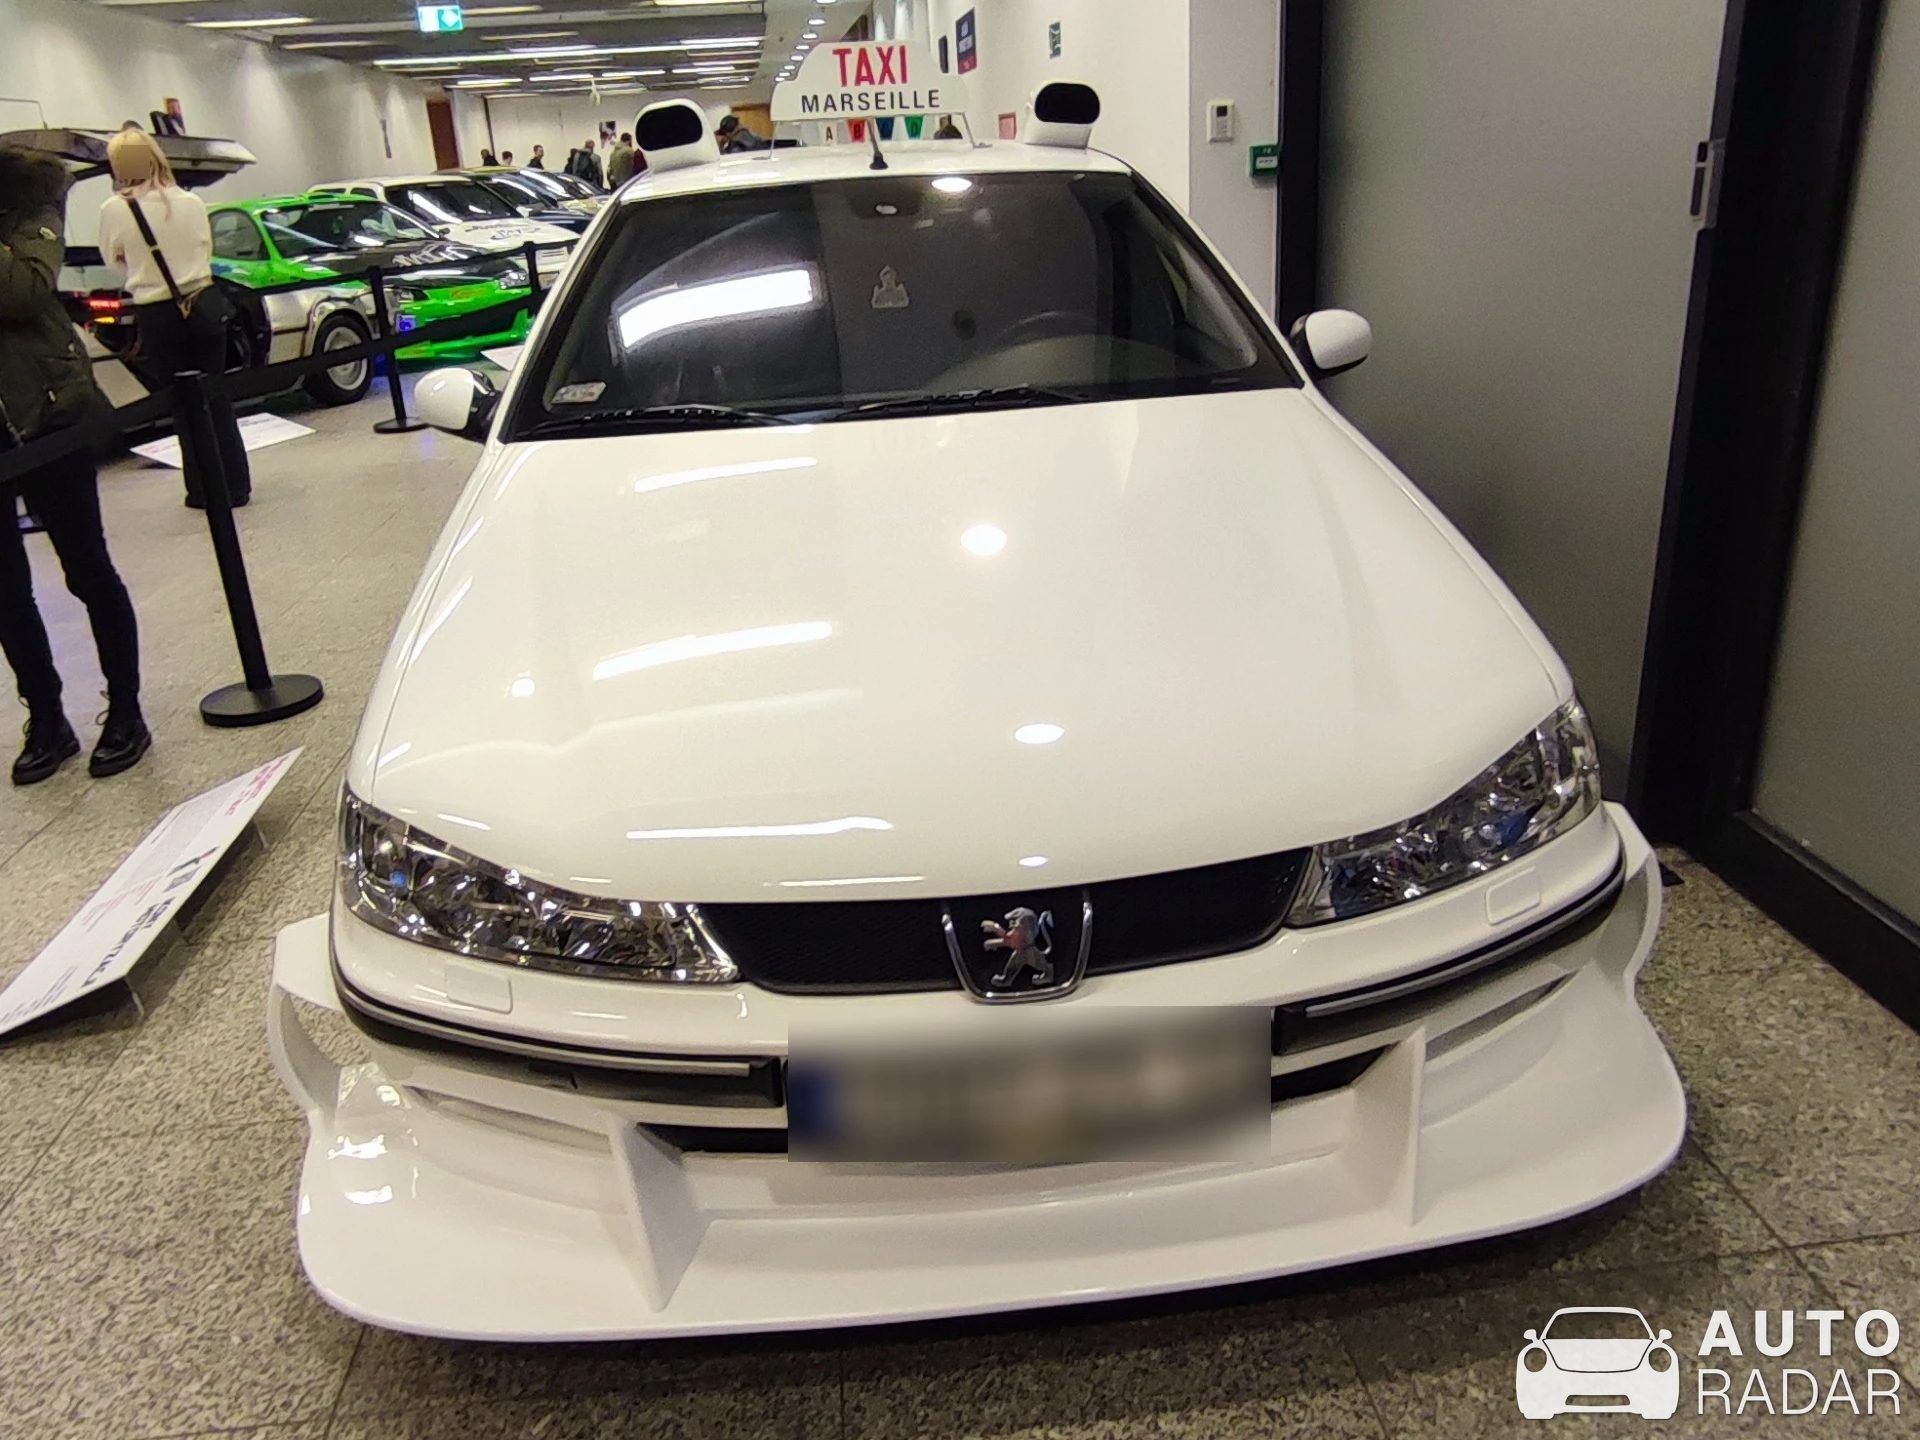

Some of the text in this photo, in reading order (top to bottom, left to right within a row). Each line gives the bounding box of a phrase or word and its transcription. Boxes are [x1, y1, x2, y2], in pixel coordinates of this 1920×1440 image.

[832, 45, 908, 87] TAXI
[801, 89, 941, 113] MARSEILLE
[825, 126, 834, 141] A
